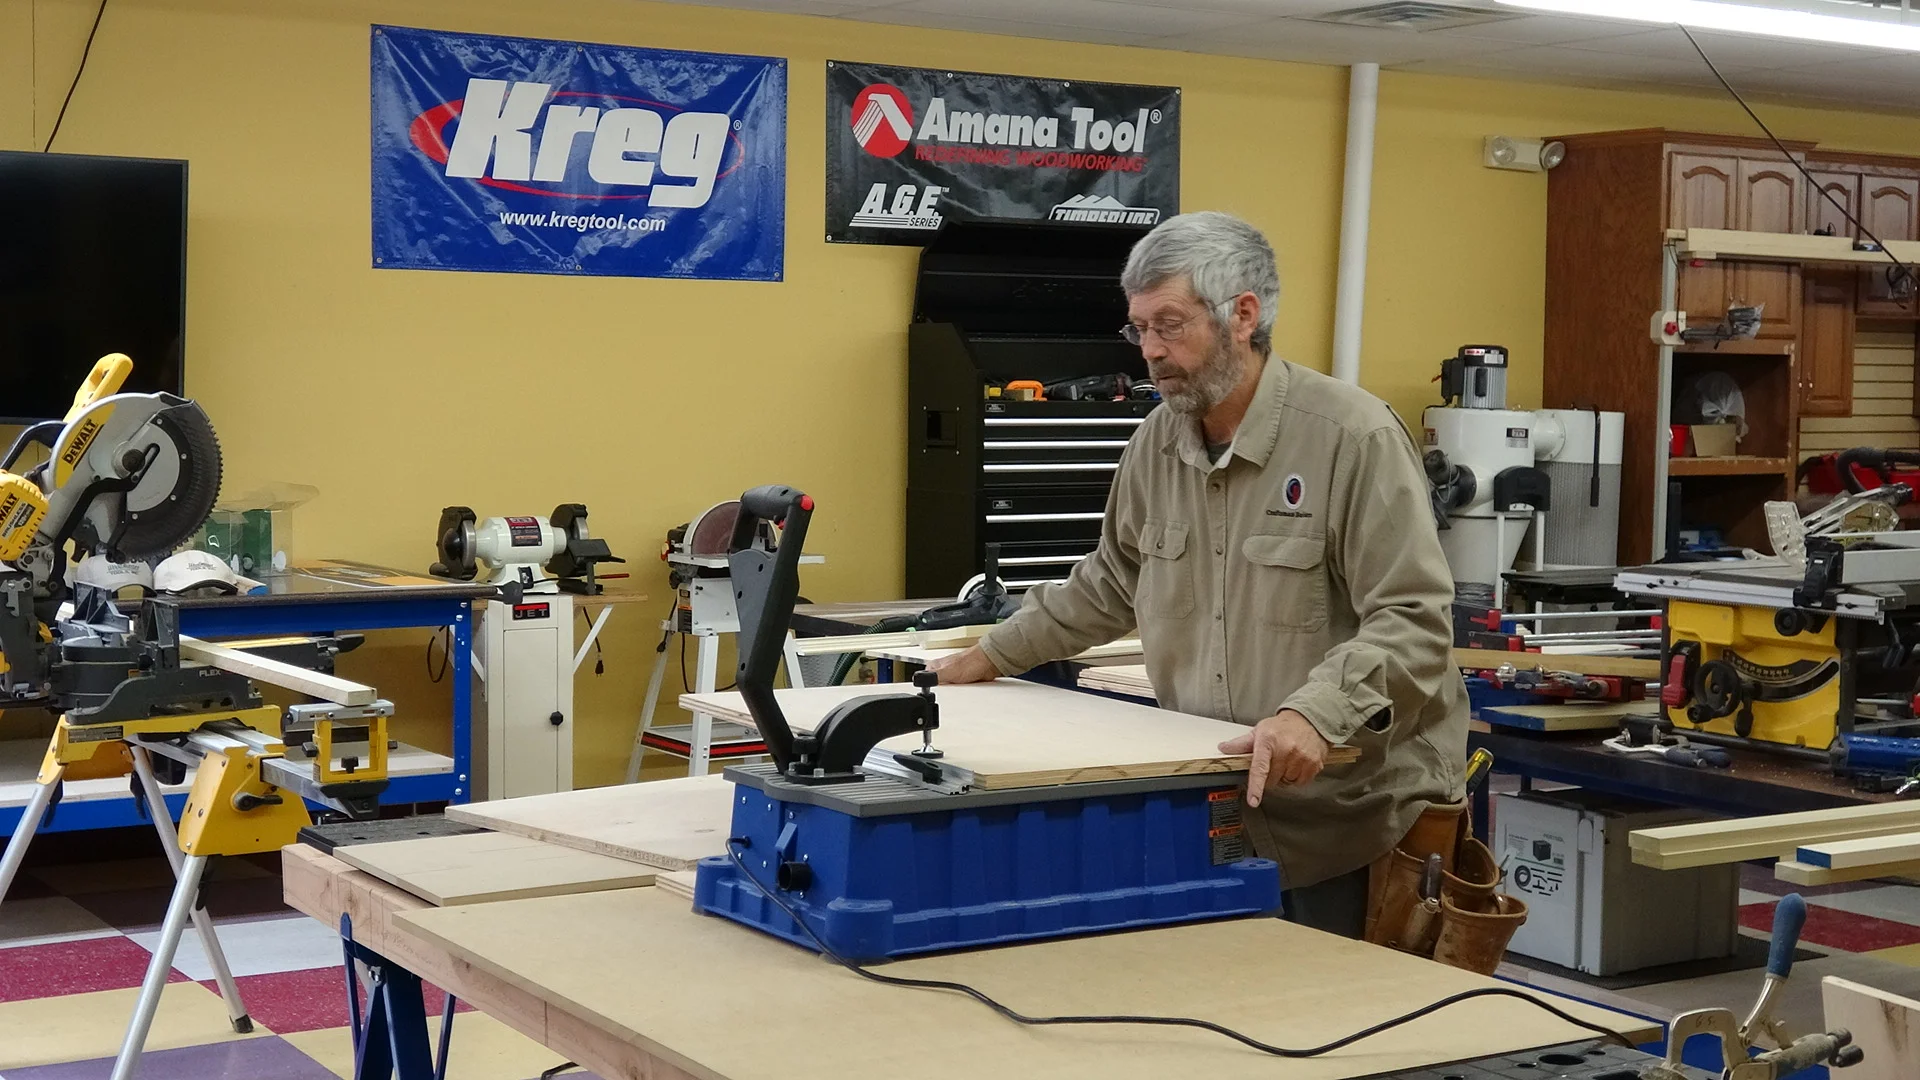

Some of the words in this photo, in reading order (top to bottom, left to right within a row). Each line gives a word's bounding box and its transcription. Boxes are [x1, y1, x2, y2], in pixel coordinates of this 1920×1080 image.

[917, 97, 1059, 148] Amana
[1071, 106, 1150, 153] Tool
[445, 77, 731, 208] Kreg
[914, 144, 1012, 166] REDEFINING
[1016, 149, 1143, 172] WOODWORKING
[858, 182, 942, 217] A.G.E.
[500, 210, 666, 232] www.kregtool.com
[909, 217, 939, 227] SERIES
[0, 494, 18, 525] WALT
[515, 609, 546, 618] JET
[199, 669, 221, 677] FLEX
